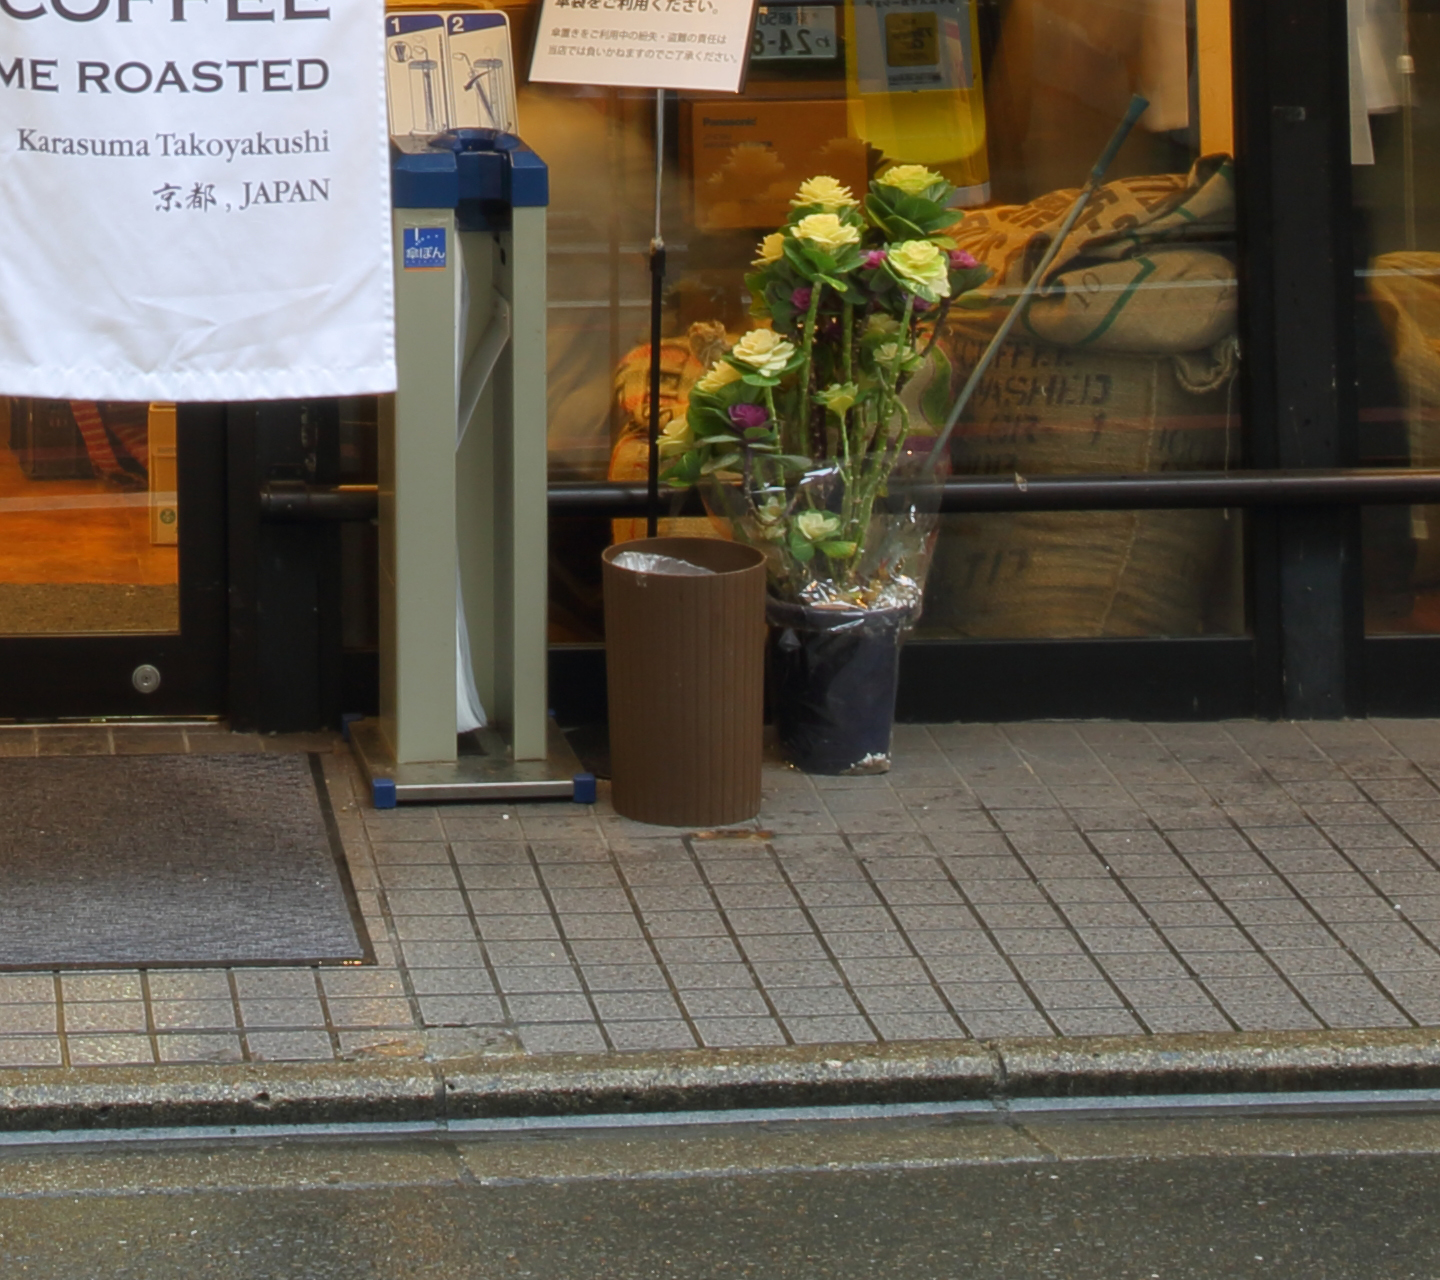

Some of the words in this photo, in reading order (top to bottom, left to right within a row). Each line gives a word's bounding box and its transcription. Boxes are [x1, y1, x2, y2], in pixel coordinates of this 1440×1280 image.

[391, 18, 401, 33] 1
[451, 17, 465, 32] 2
[547, 45, 739, 64] 当店では負いかねますのでご了承ください。
[76, 58, 331, 94] ROASTED
[17, 128, 150, 158] Karasuma
[155, 129, 331, 162] Takoyakushi
[238, 177, 331, 210] JAPAN
